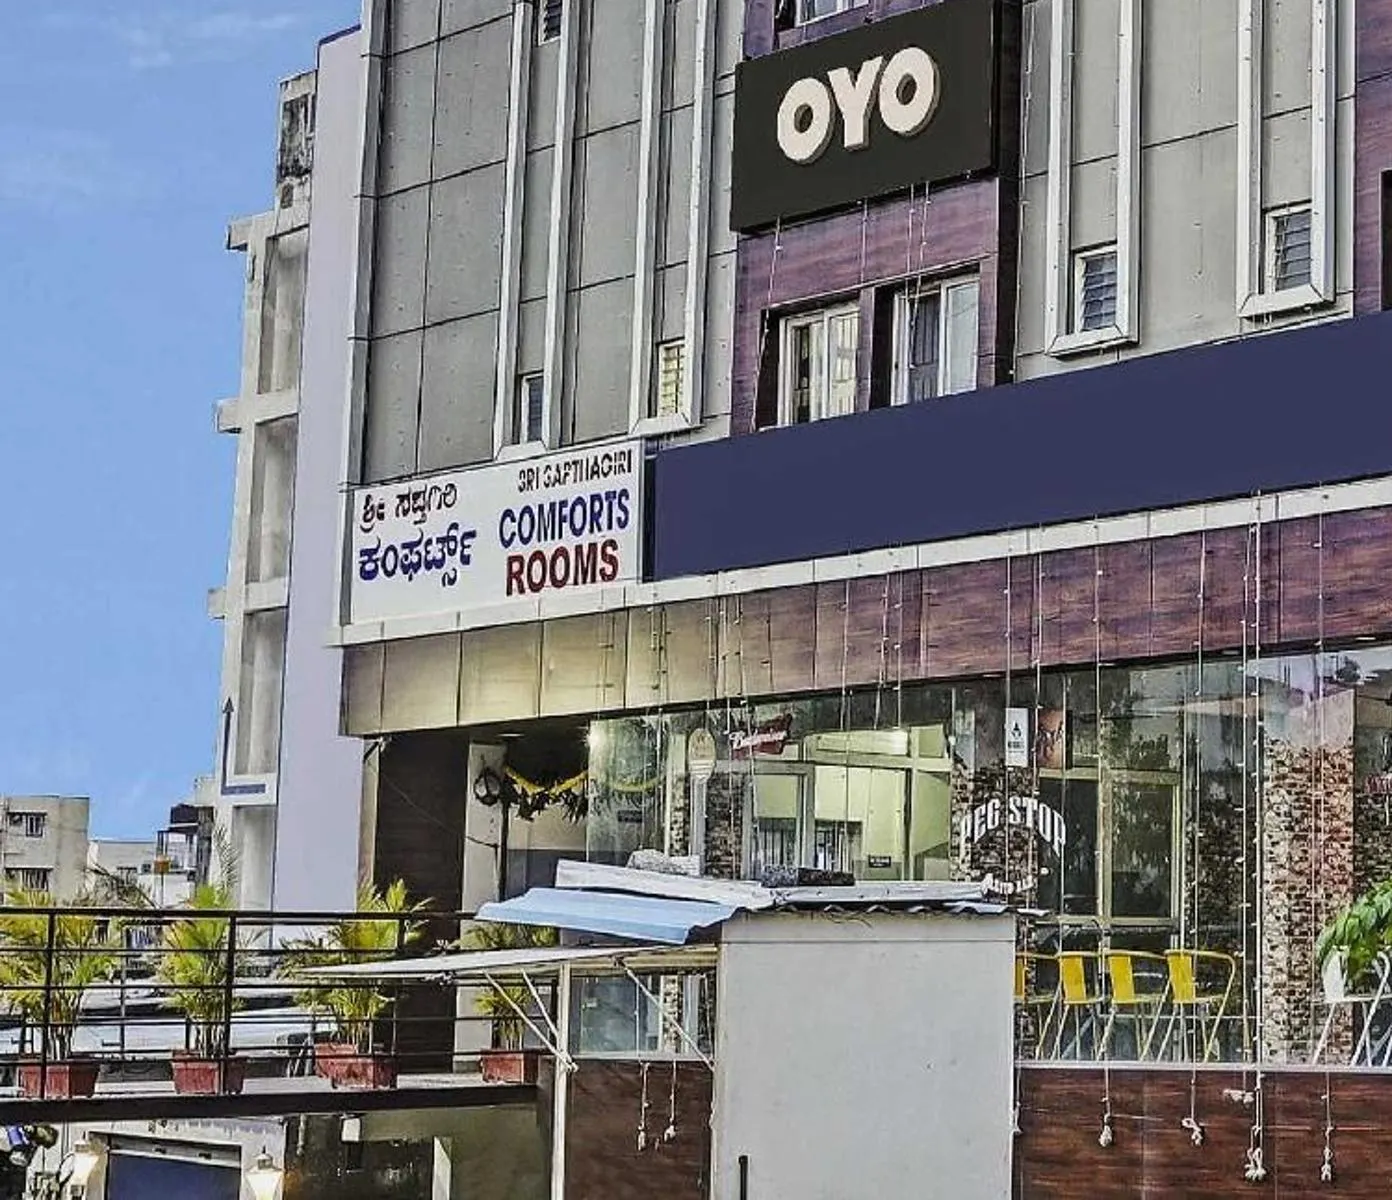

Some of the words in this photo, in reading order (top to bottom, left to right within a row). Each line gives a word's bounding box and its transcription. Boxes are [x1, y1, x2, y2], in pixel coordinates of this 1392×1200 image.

[777, 46, 941, 165] OYO
[518, 466, 540, 493] SRI
[359, 493, 386, 535] ಶ್ರೀ
[499, 488, 631, 549] COMFORTS
[505, 538, 620, 597] ROOMS
[1008, 795, 1067, 858] STOP
